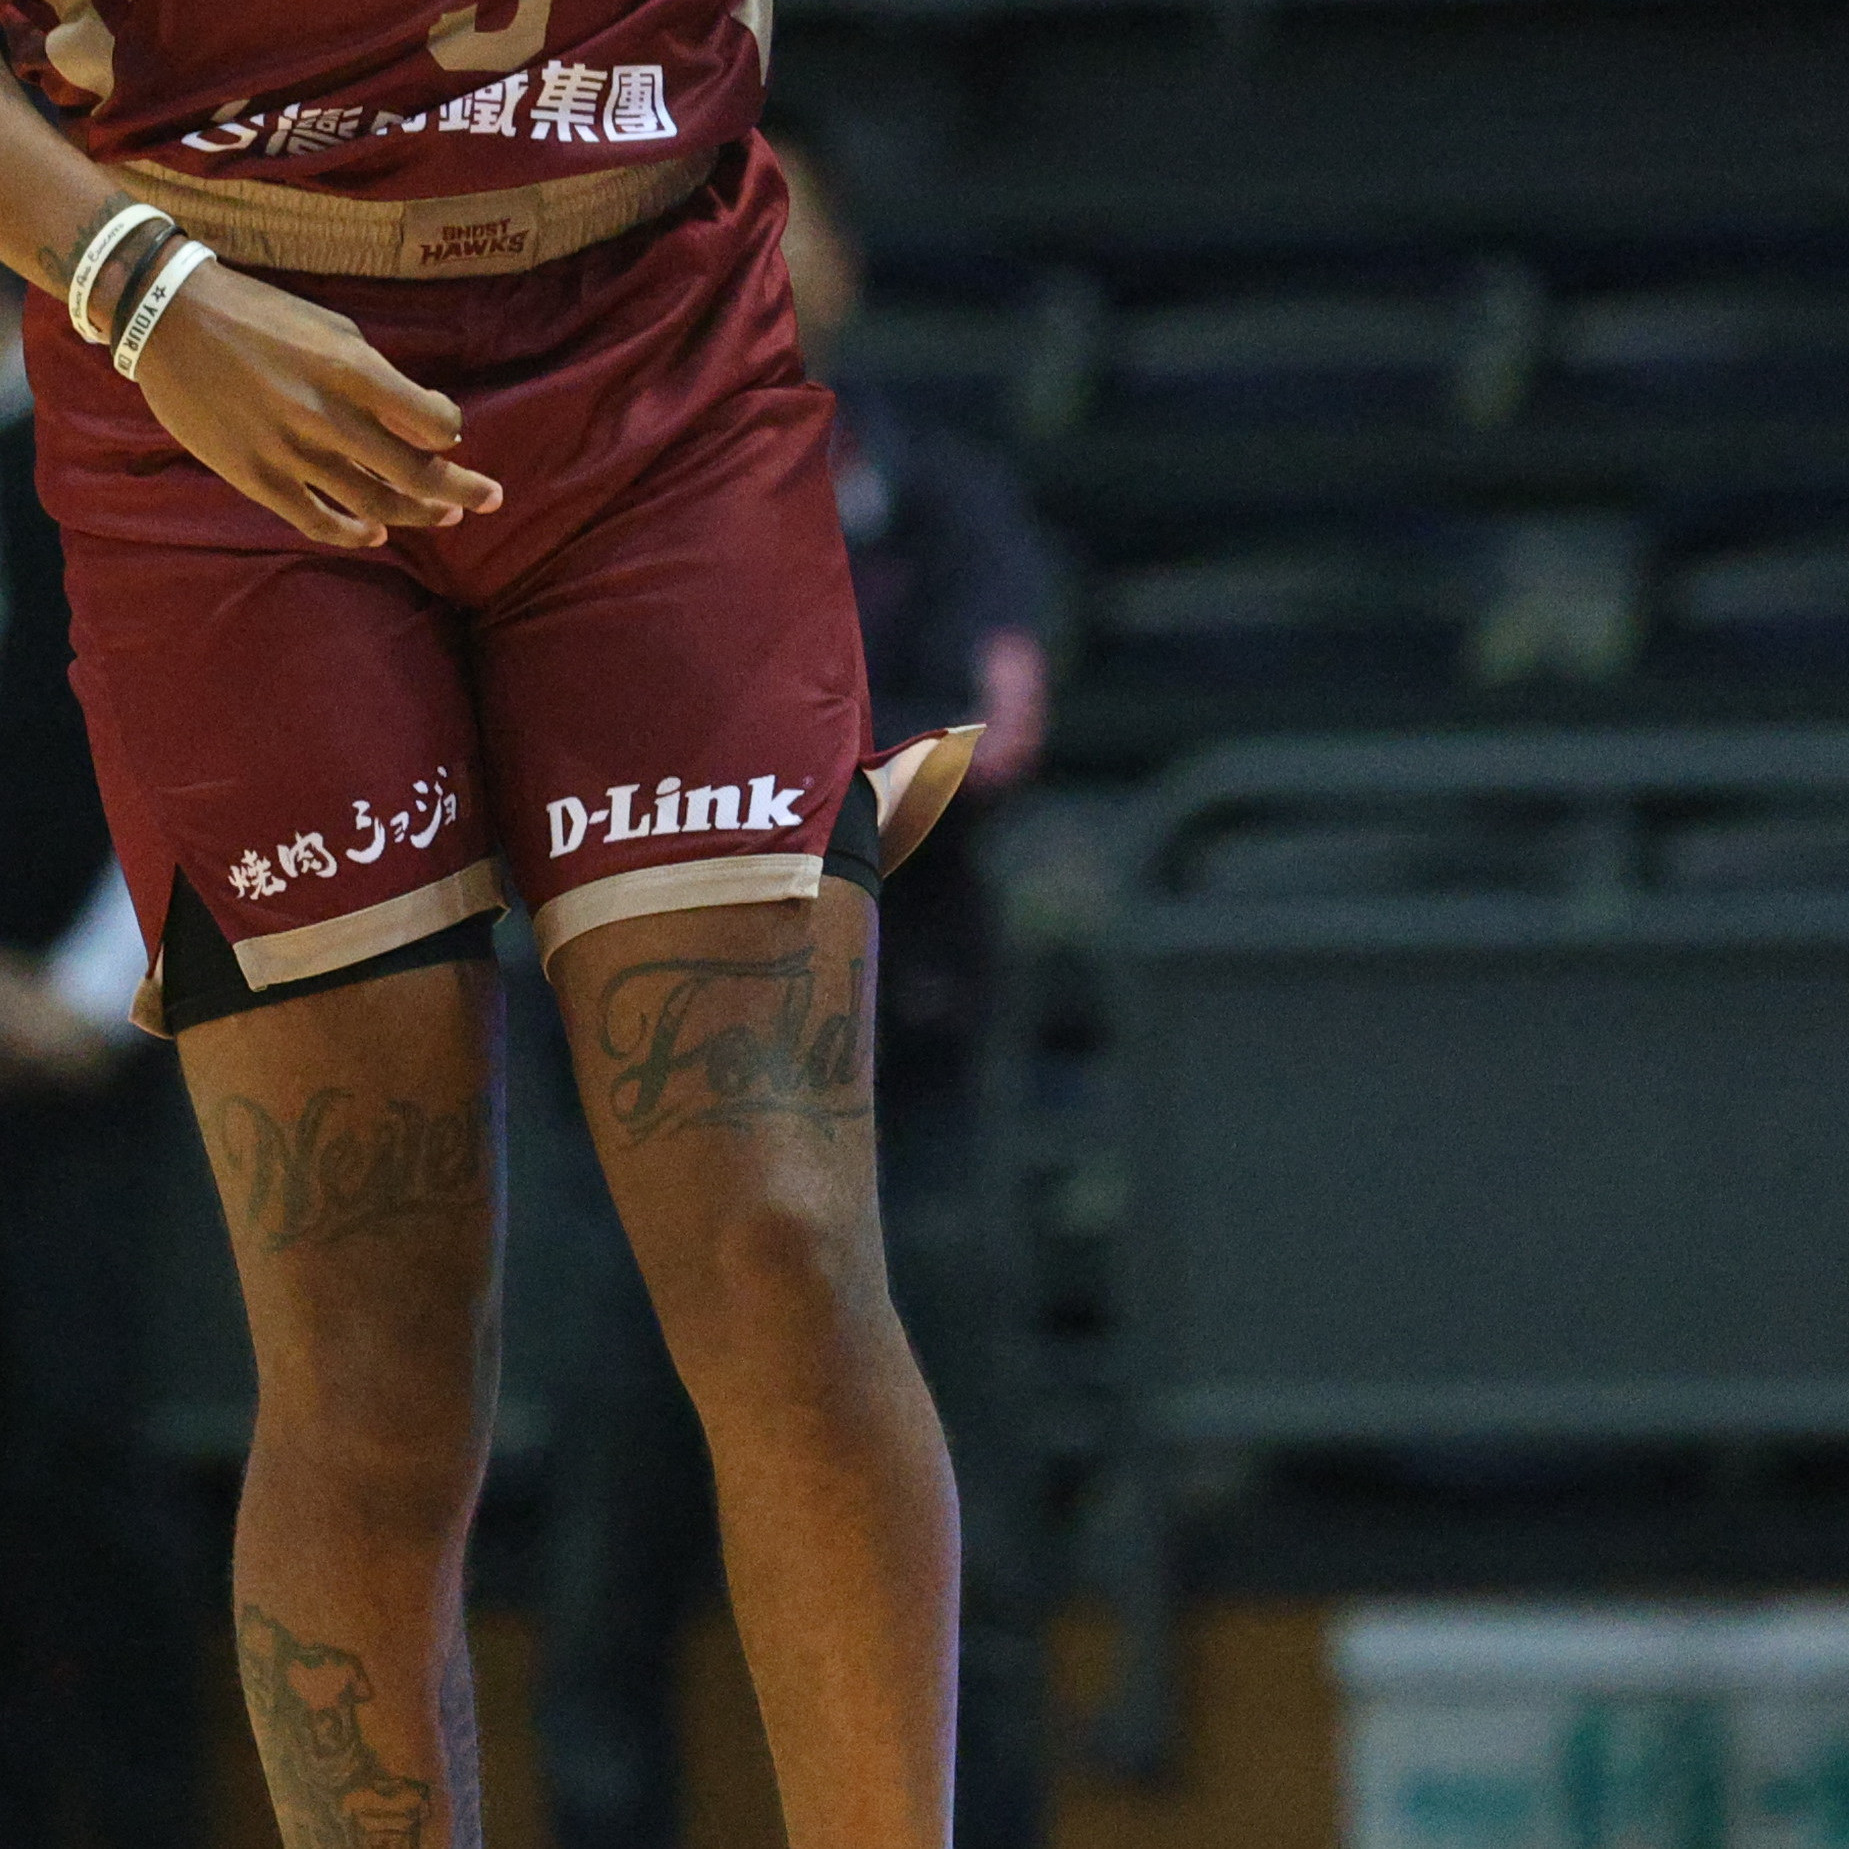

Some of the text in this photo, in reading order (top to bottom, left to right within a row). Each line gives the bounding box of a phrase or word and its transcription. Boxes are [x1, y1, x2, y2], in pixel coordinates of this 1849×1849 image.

[419, 229, 531, 266] HAWKS
[441, 217, 512, 242] GHOST
[122, 303, 159, 352] YOUR
[546, 773, 806, 859] D-Link
